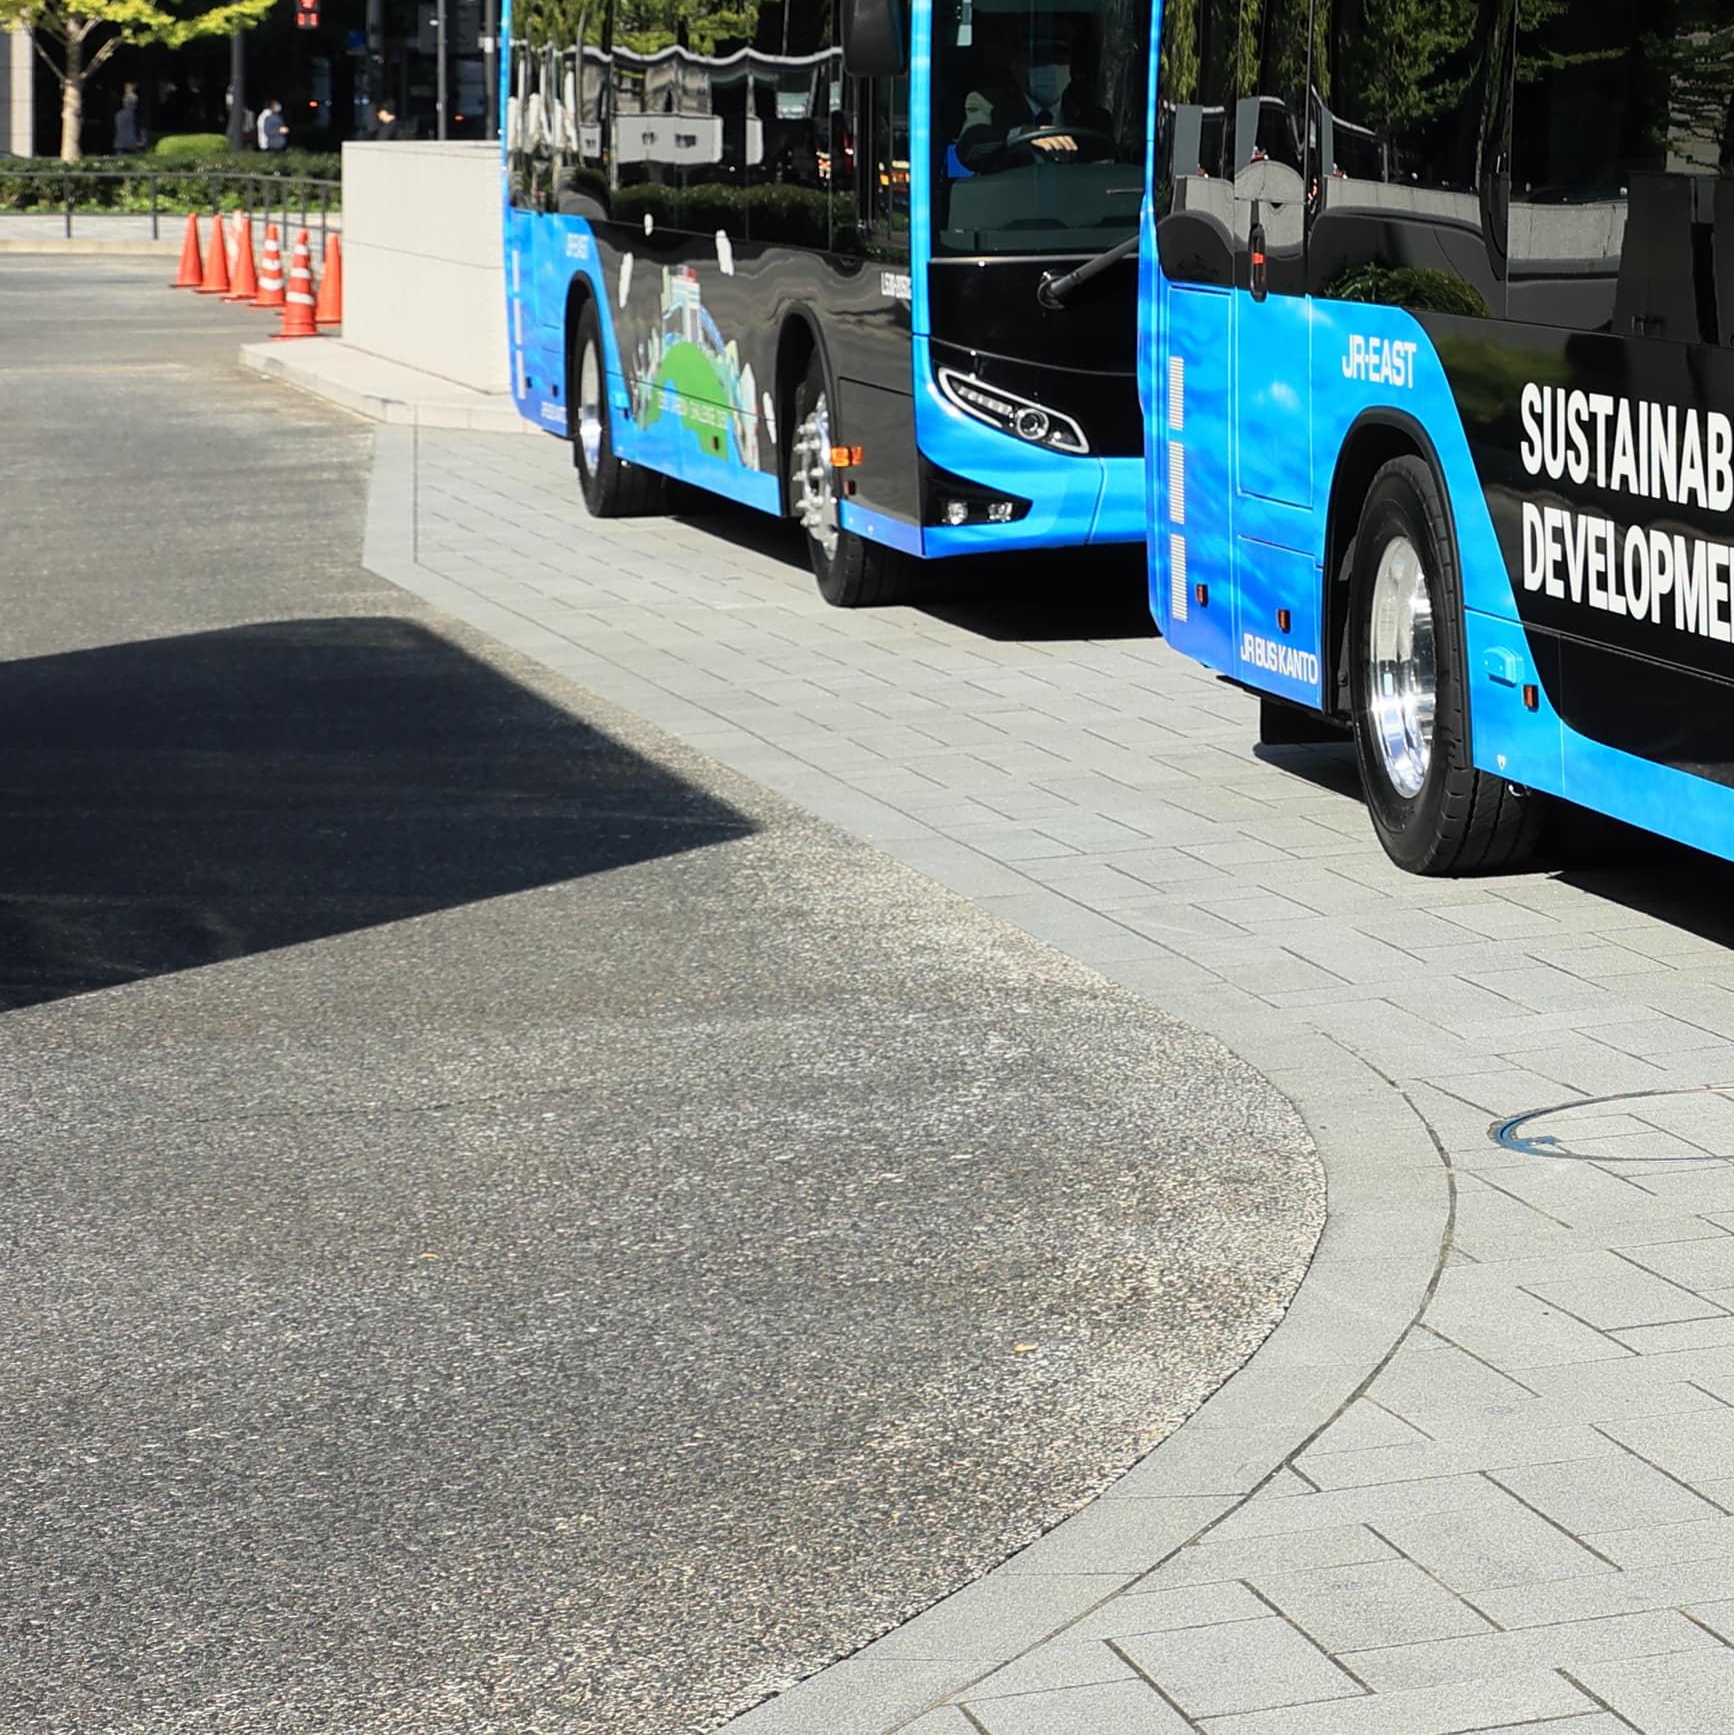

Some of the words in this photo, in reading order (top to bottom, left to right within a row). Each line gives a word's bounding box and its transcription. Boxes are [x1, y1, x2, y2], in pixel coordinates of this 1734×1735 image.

[1240, 632, 1255, 664] JR
[1255, 637, 1277, 674] BUS
[1276, 644, 1319, 685] KANTO
